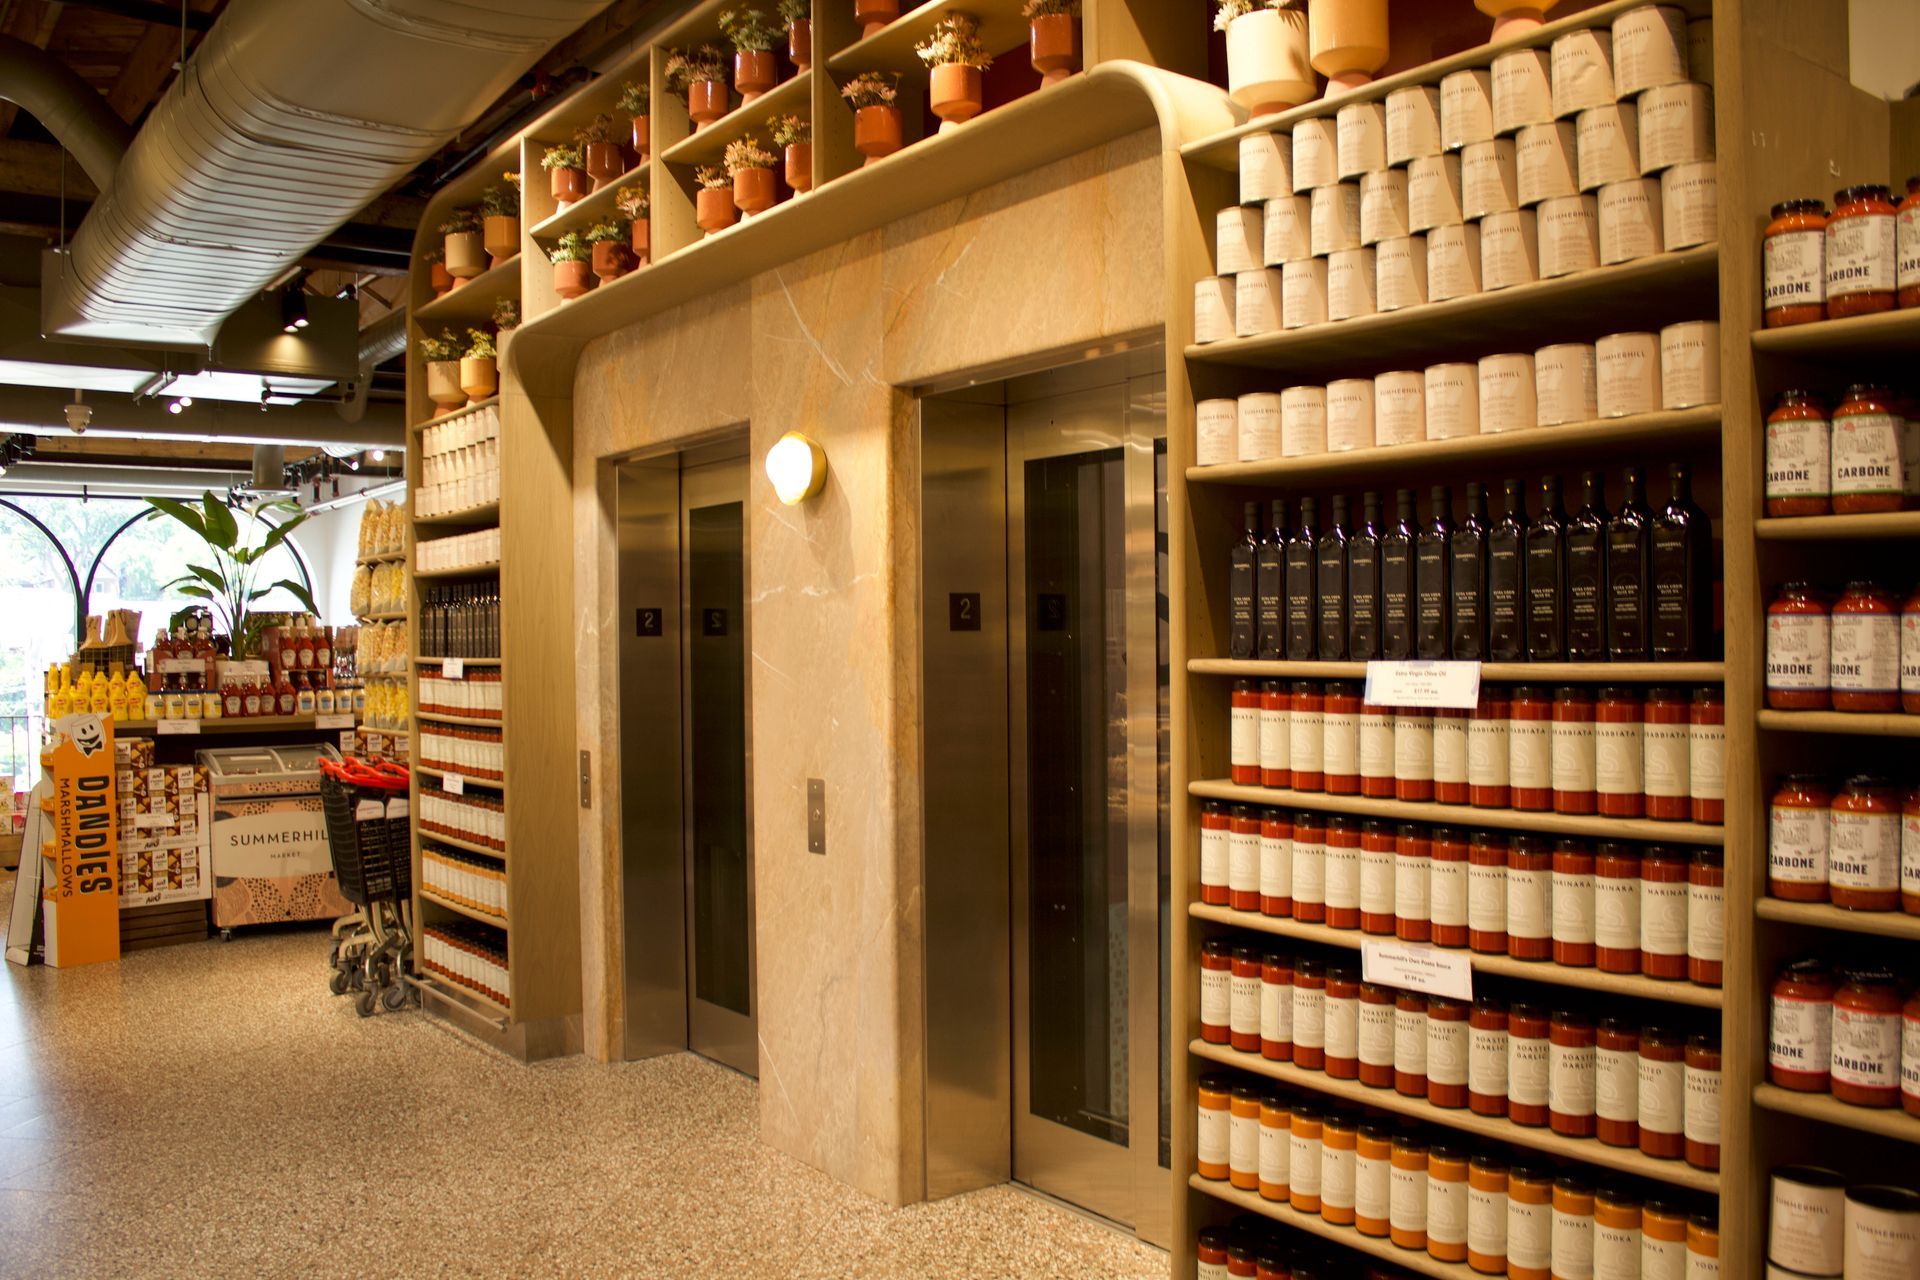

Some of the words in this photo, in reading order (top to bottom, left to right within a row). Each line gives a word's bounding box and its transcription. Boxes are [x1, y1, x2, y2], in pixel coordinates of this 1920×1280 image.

[1837, 465, 1891, 480] CARBONE
[960, 598, 971, 620] 2
[644, 611, 654, 628] 2
[60, 777, 73, 898] MARSHMALLOWS
[75, 775, 113, 894] DANDIES
[230, 829, 328, 847] SUMMERHIL
[1830, 860, 1869, 875] ARBONE
[1647, 888, 1688, 897] MARINAR
[1475, 1035, 1508, 1044] ROASTE
[1516, 1043, 1550, 1053] ROASTE
[1833, 1053, 1887, 1075] CARBONE
[1687, 1074, 1722, 1086] ROASTE
[1559, 1218, 1588, 1230] VODKA
[1601, 1231, 1632, 1243] VODKA
[1695, 1259, 1719, 1272] VODK
